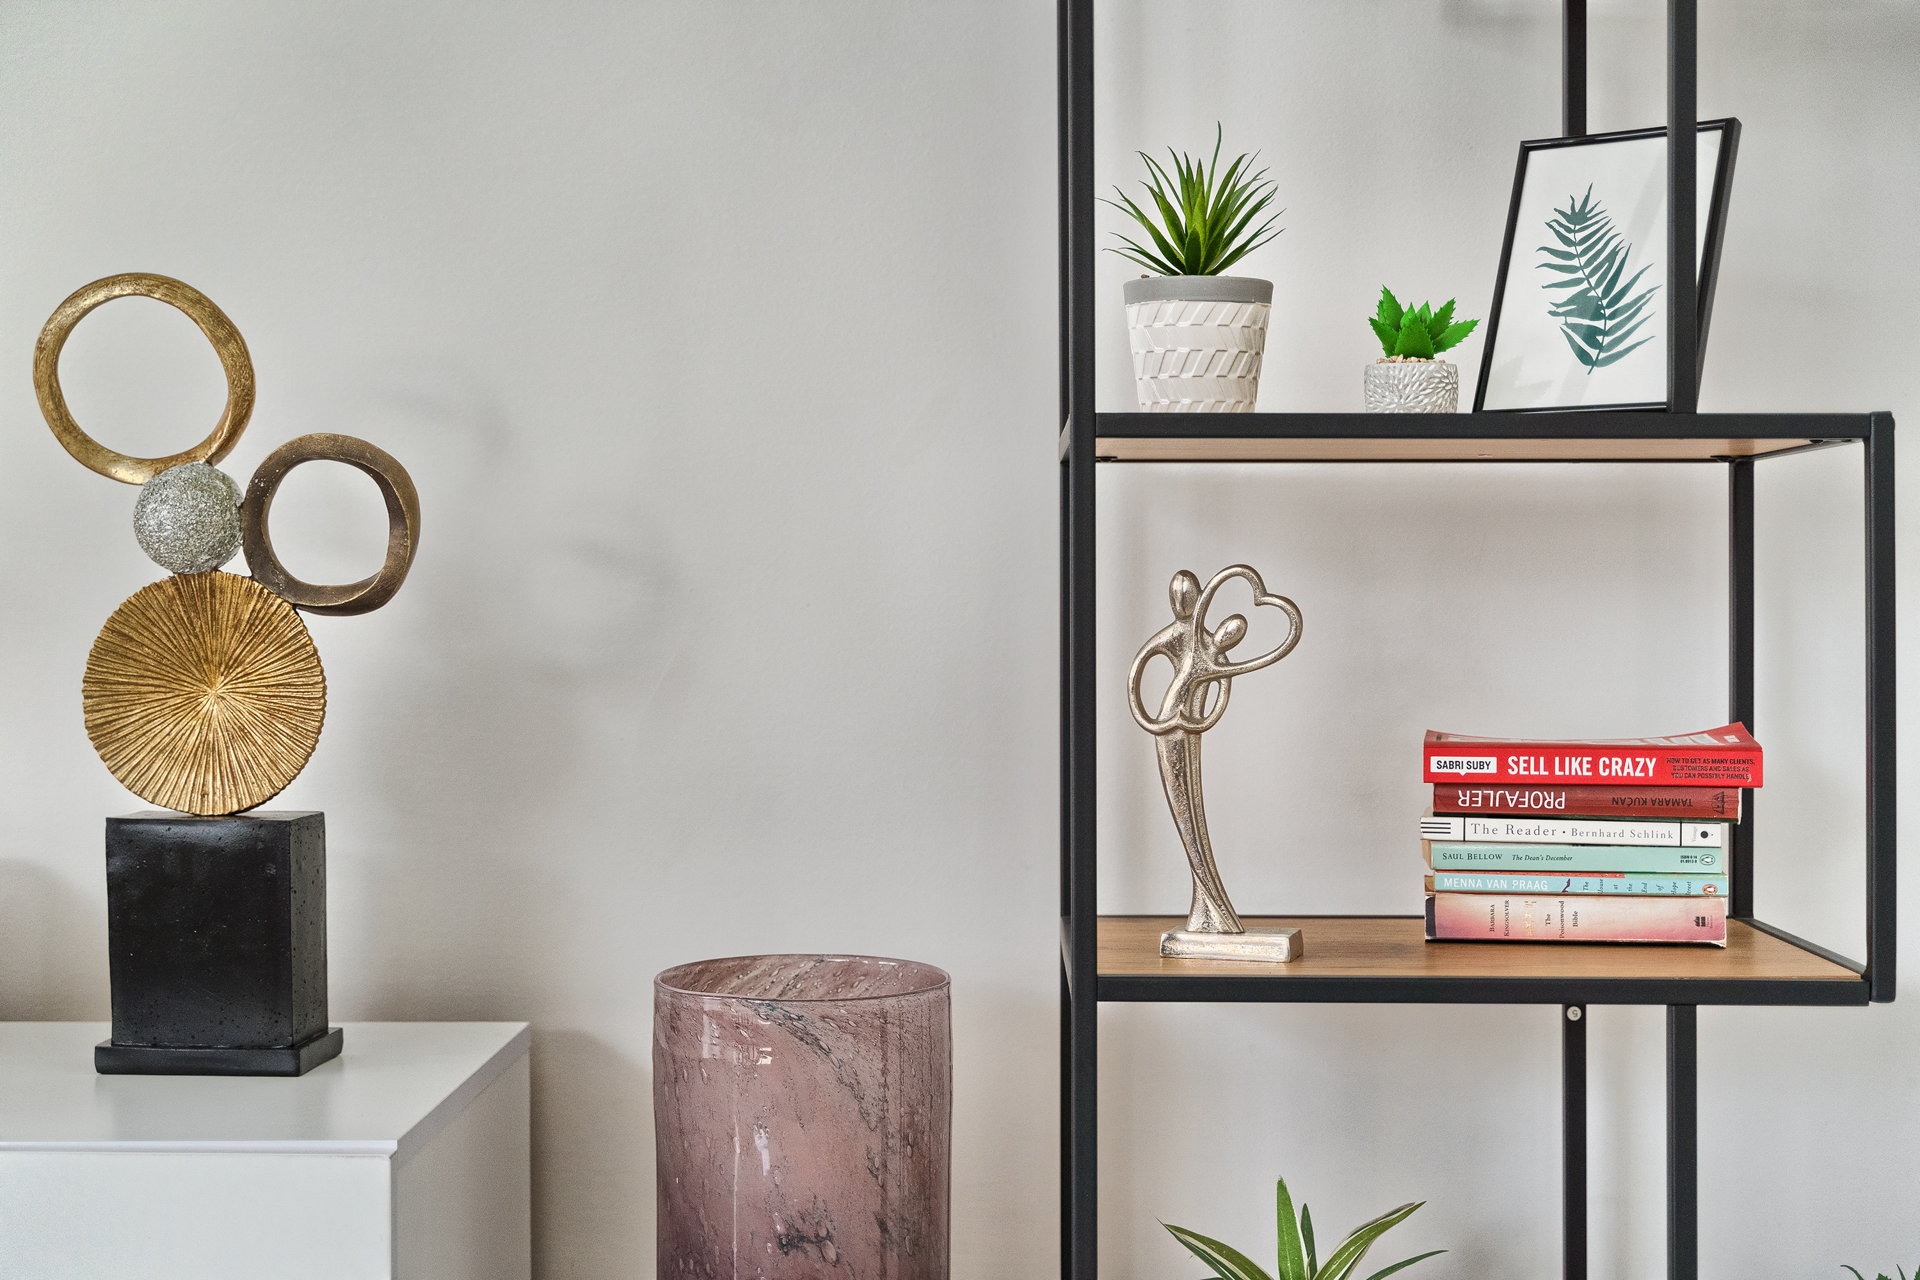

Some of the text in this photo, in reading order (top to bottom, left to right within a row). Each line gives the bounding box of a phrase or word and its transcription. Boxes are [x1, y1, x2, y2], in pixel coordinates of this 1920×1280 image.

[1436, 760, 1492, 770] SABRI SUBY
[1507, 756, 1657, 777] SELL LIKE CRAZY
[1457, 790, 1566, 810] PROFAJLER
[1651, 797, 1694, 807] TAMARA
[1471, 823, 1674, 839] The Reader Bernhard Schlink
[1442, 852, 1503, 861] SAUL BELLOW
[1443, 878, 1549, 890] MENNA VAN PRAAG
